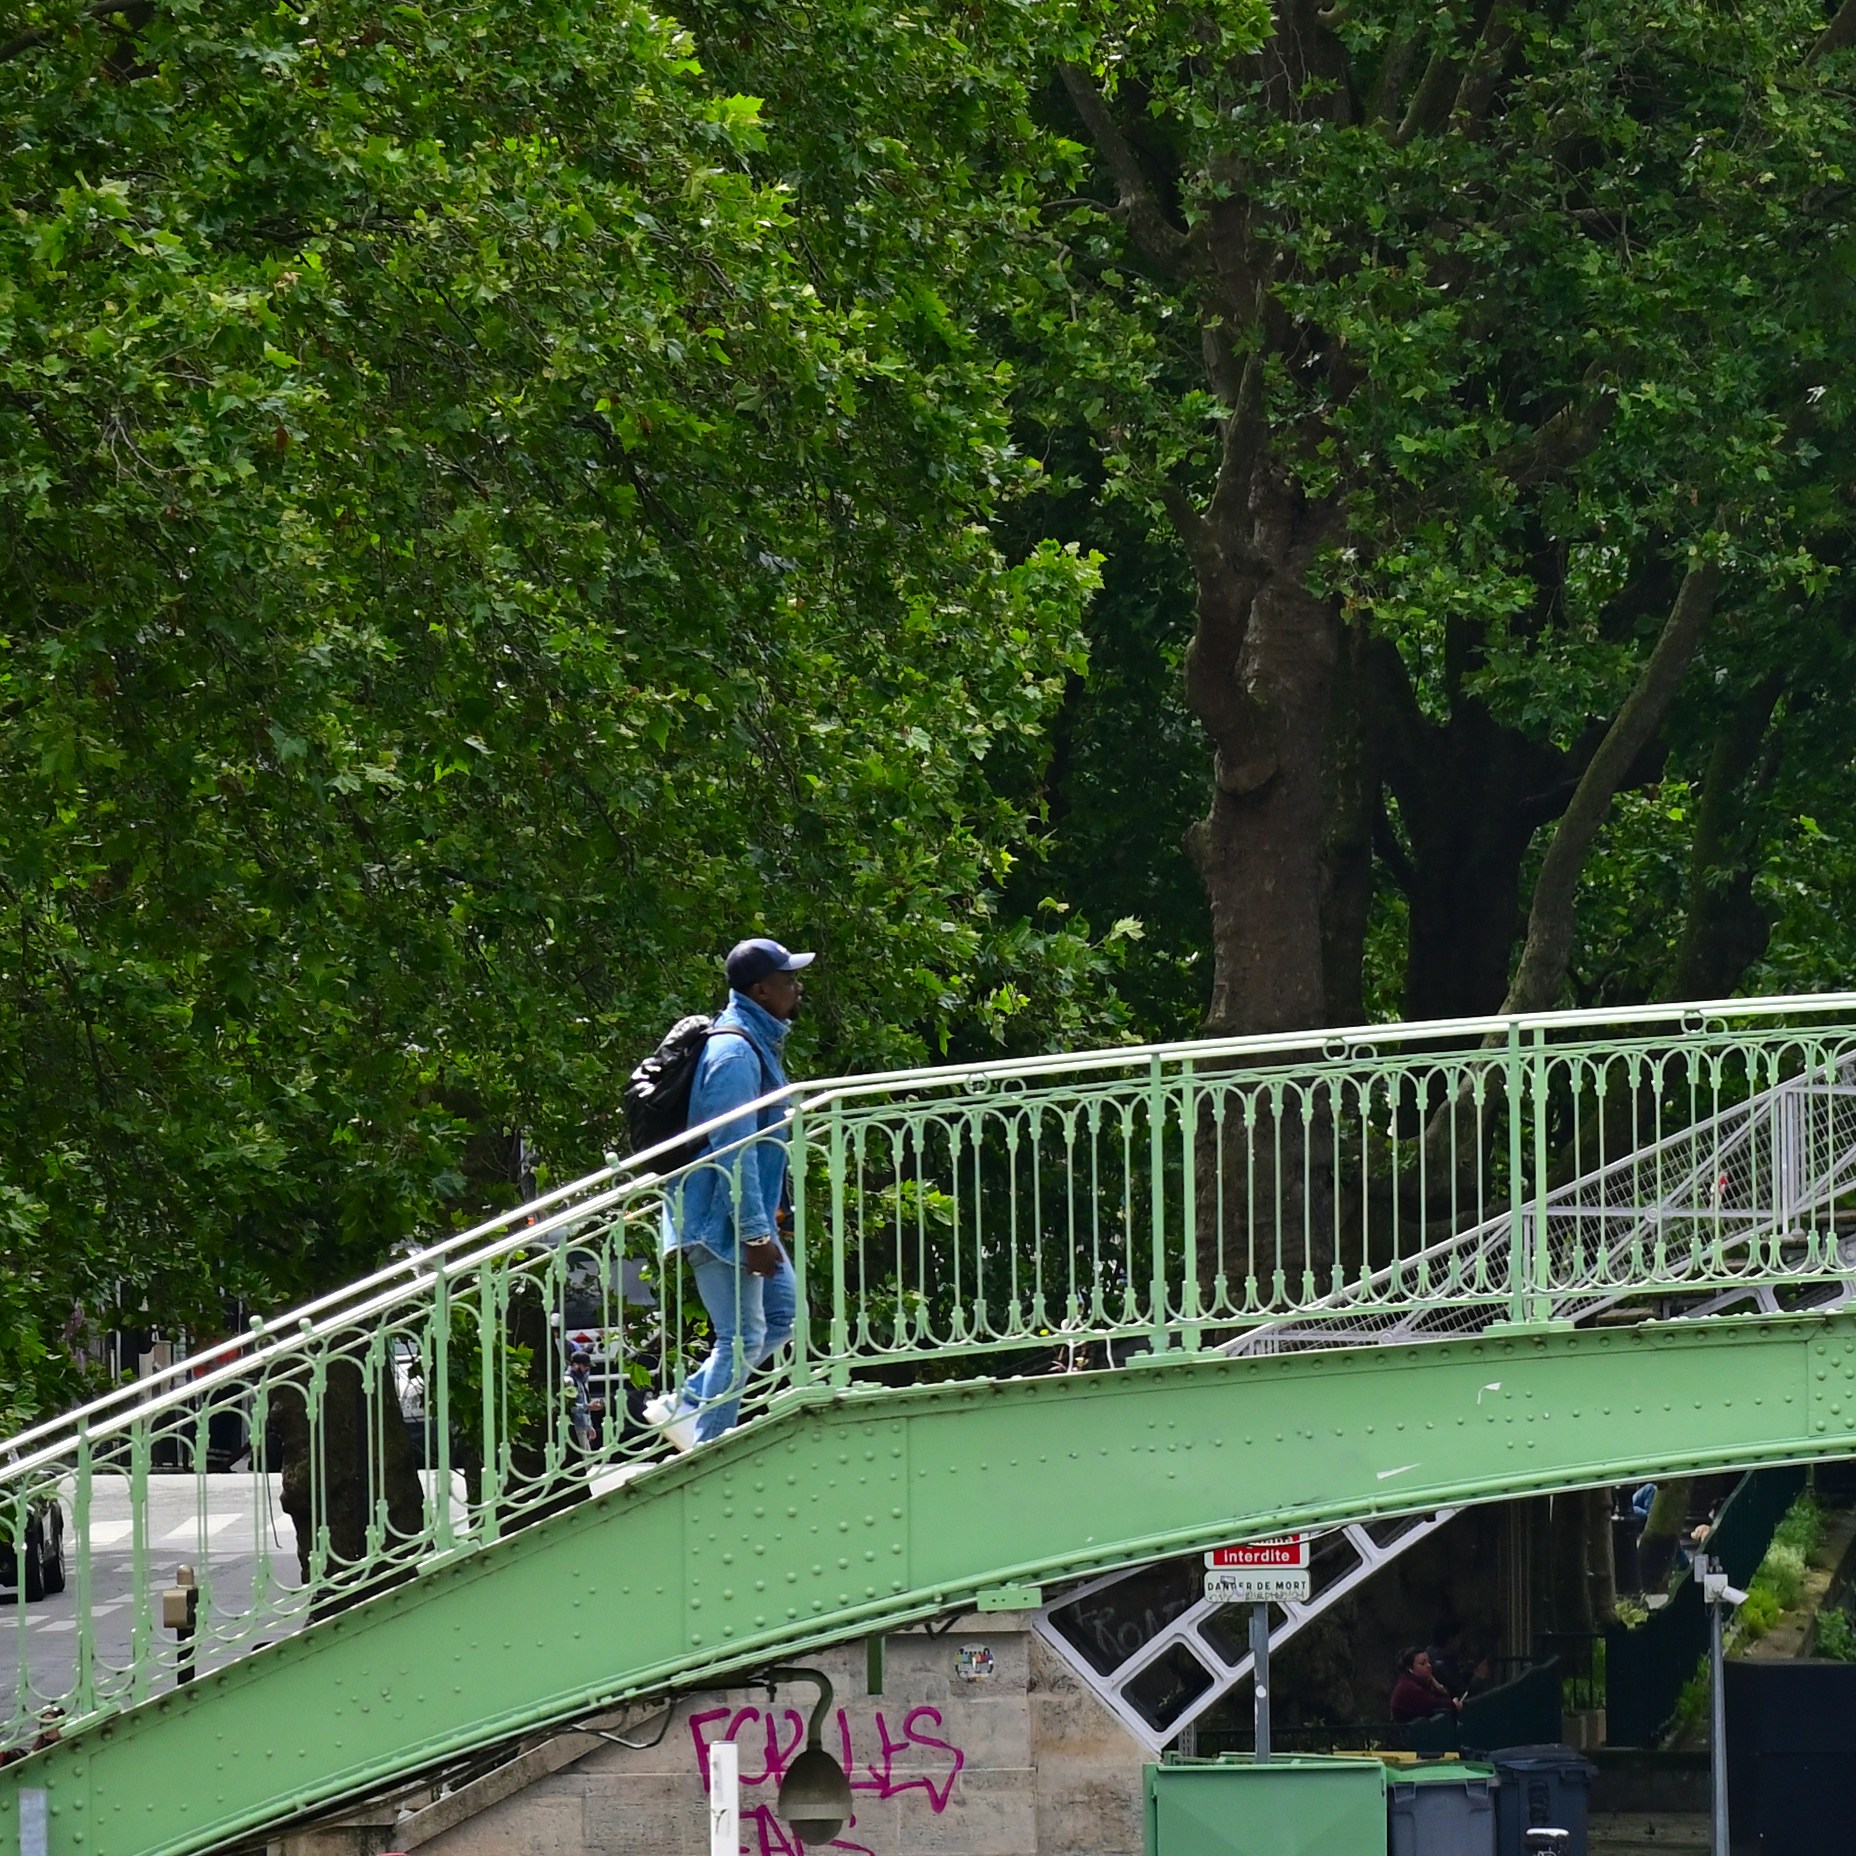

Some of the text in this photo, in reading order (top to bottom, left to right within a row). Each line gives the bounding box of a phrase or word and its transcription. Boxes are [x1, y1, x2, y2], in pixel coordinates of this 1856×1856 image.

[1224, 1549, 1291, 1563] interdite
[1207, 1580, 1306, 1592] DANER DE MORT
